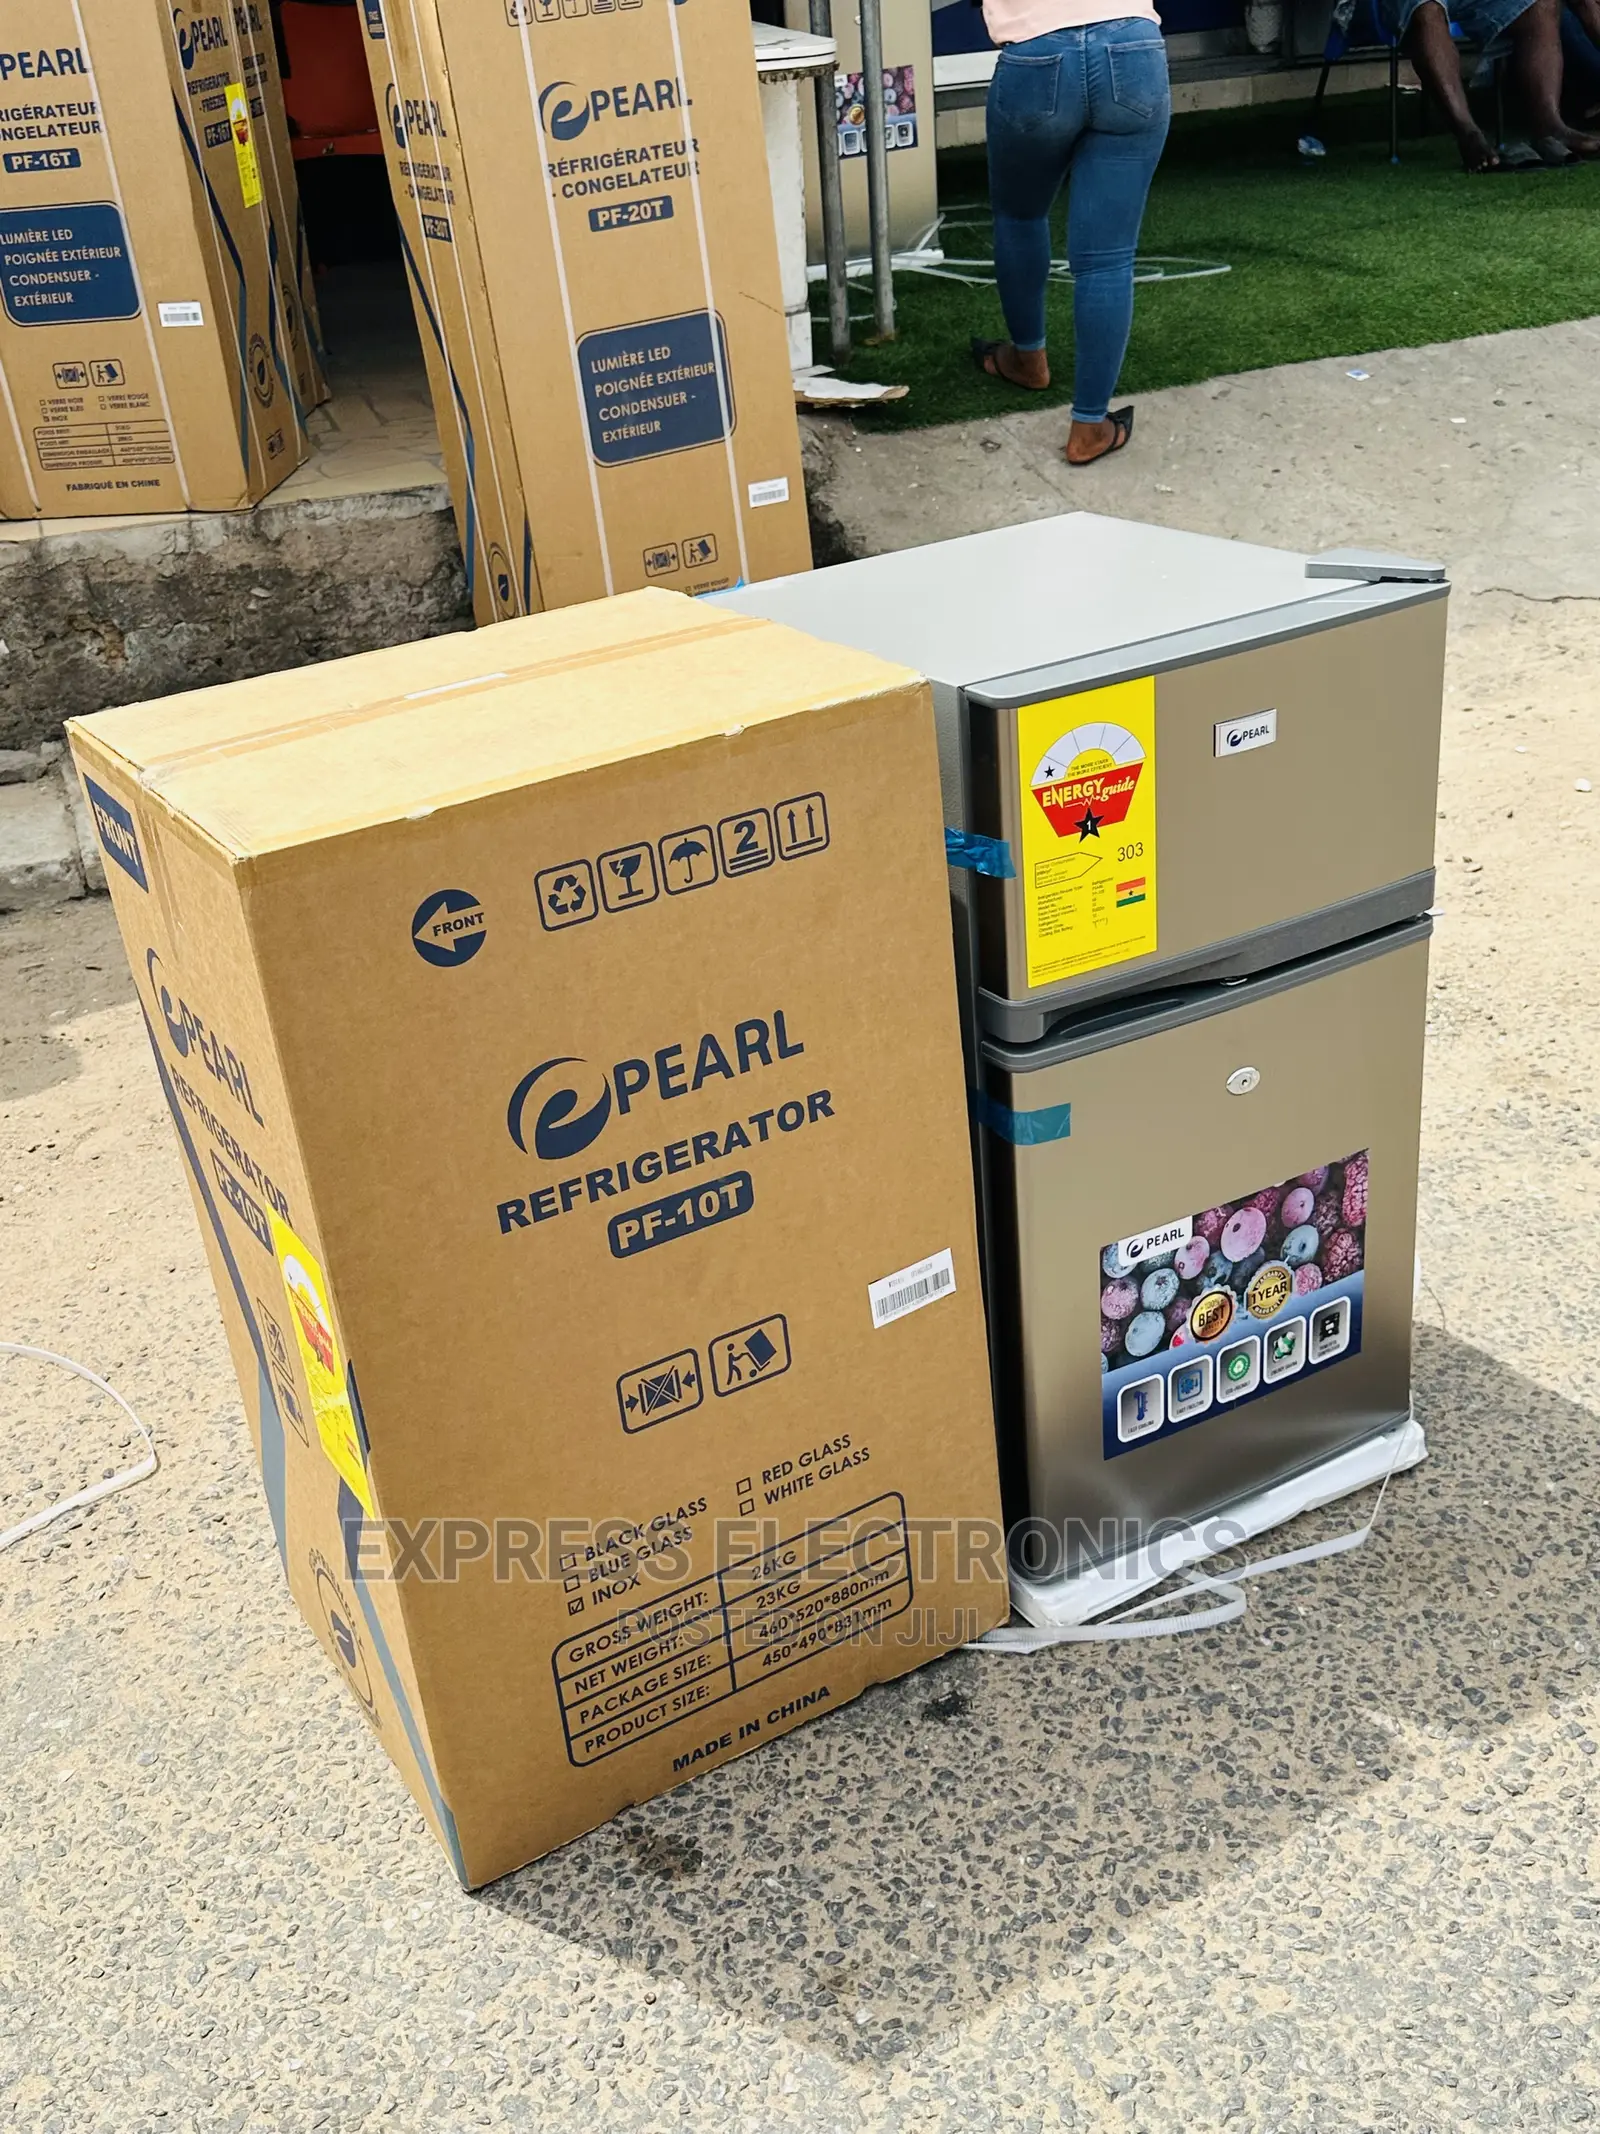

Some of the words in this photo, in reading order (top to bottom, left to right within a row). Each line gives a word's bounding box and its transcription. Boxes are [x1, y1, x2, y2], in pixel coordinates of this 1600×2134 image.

[190, 16, 229, 53] PEARL
[0, 47, 88, 80] PEARL
[0, 121, 101, 140] NGELATEUR
[405, 99, 447, 138] PEARL
[11, 151, 71, 170] PF-16T
[547, 138, 700, 179] RÉFRIGÉRATEUR
[597, 200, 664, 228] PF-20T
[0, 228, 50, 245] LUMIÈRE
[51, 229, 73, 241] LED
[4, 248, 59, 265] POIGNÉE
[61, 245, 121, 262] EXTÉRIEUR
[9, 270, 91, 286] CONDENSUER
[14, 291, 74, 307] EXTÉRIEUR
[591, 351, 645, 374] LUMIÈRE
[648, 346, 671, 362] LED
[595, 371, 654, 398] POIGNÉE
[657, 362, 715, 385] EXTÉRIEUR
[599, 391, 688, 421] CONDENSUER
[602, 420, 661, 443] EXTÉRIEUR
[66, 480, 113, 492] FABRIQUÉ
[116, 481, 129, 489] EN
[132, 479, 160, 488] CHINE
[1242, 724, 1269, 741] PEARL
[1042, 777, 1105, 809] ENERGY
[1100, 776, 1135, 802] guide
[93, 800, 138, 867] FRONT
[1117, 842, 1144, 862] 303
[432, 912, 484, 937] FRONT
[178, 998, 264, 1128] PEARL
[612, 1009, 805, 1115] PEARL
[170, 1063, 294, 1230] REFRIGERATOR
[496, 1089, 835, 1234] REFRIGERATOR
[617, 1180, 744, 1250] PF-10T
[1146, 1228, 1184, 1249] PEARL
[1258, 1281, 1288, 1302] YEAR
[1198, 1304, 1225, 1327] BEST
[762, 1461, 793, 1485] RED
[798, 1434, 851, 1468] GLASS
[764, 1473, 814, 1505] WHITE
[818, 1447, 870, 1480] GLASS
[584, 1524, 645, 1561] BLACK
[651, 1497, 708, 1532] GLASS
[589, 1553, 631, 1582] BLUE
[636, 1526, 693, 1560] GLASS
[751, 1550, 797, 1581] 26KG
[592, 1572, 642, 1605] INOX
[756, 1580, 800, 1610] 23KG
[569, 1625, 632, 1662] GROSS
[636, 1592, 708, 1632] WEIGHT:
[574, 1669, 606, 1694] NET
[611, 1636, 683, 1677] WEIGHT:
[580, 1672, 669, 1724] PACKAGE
[673, 1654, 711, 1680] SIZE:
[585, 1703, 667, 1753] PRODUCT
[672, 1685, 710, 1711] SIZE:
[673, 1732, 733, 1772] MADE
[739, 1719, 761, 1740] IN
[767, 1686, 831, 1724] CHINA
